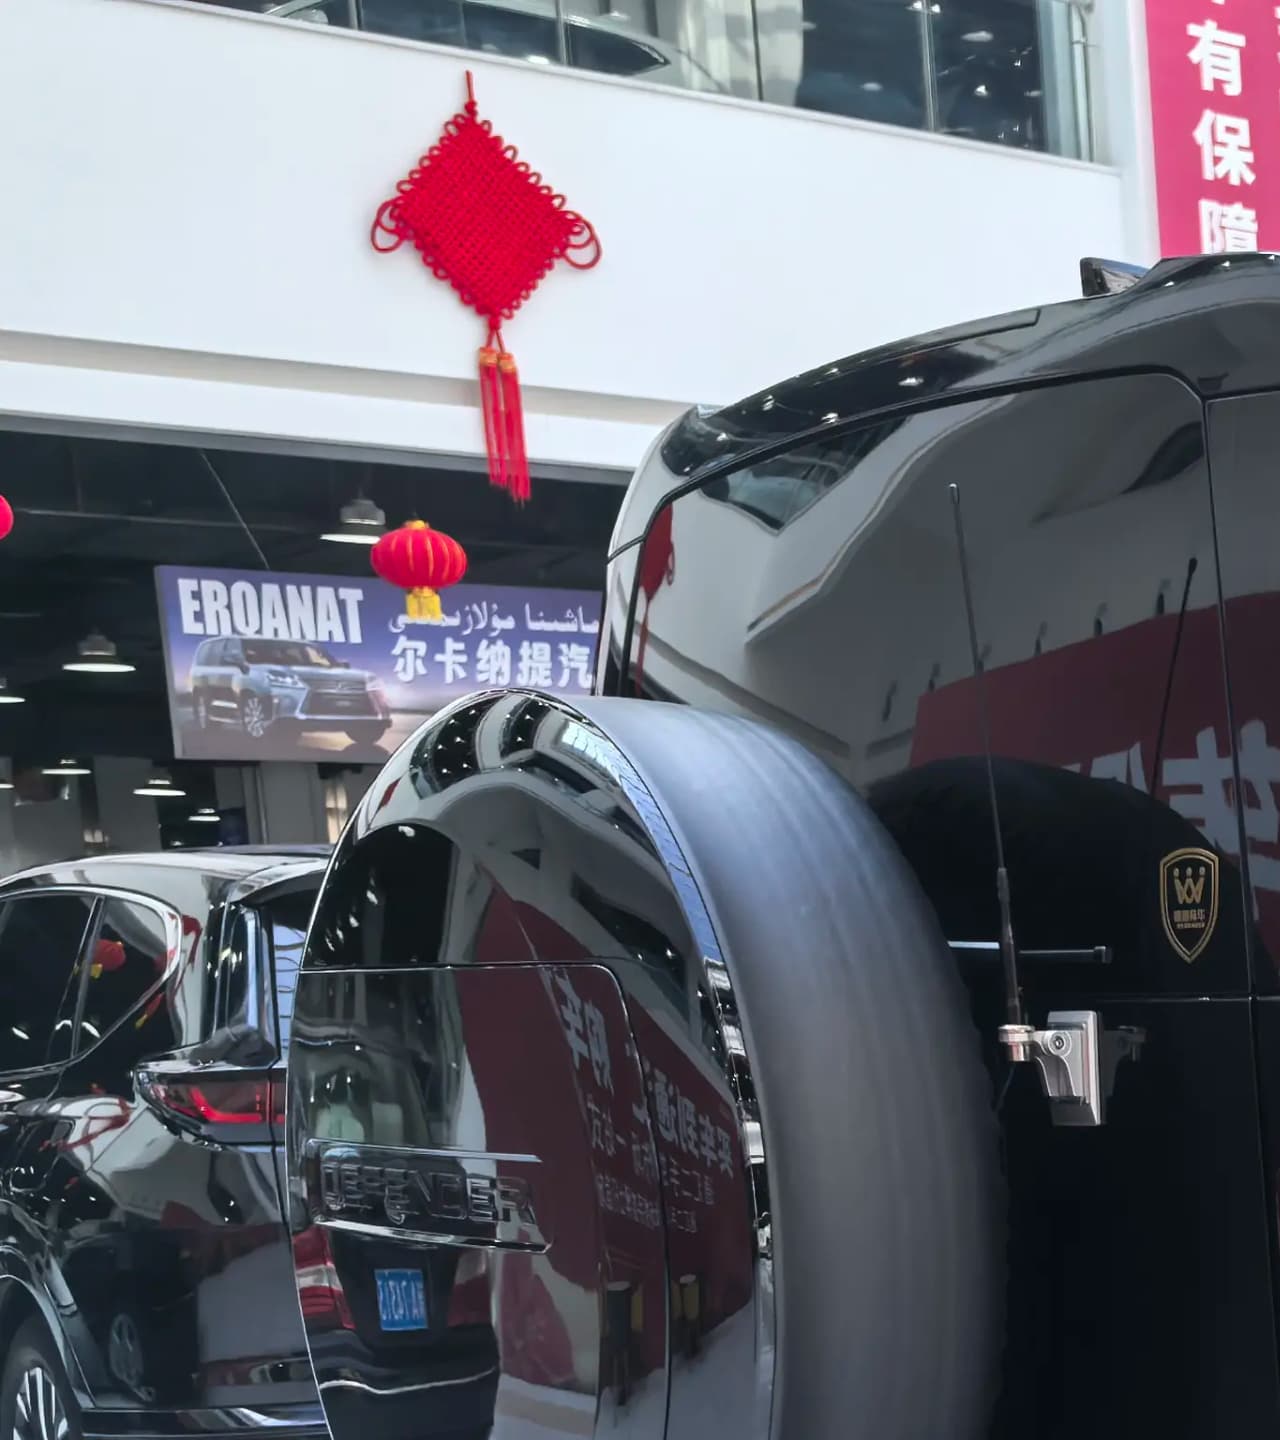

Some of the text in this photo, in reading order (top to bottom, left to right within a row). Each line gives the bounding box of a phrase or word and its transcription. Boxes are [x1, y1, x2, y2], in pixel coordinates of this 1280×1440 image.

[1186, 0, 1259, 254] 有保障
[177, 579, 364, 645] ERQANAT
[391, 635, 593, 689] 尔卡纳提汽
